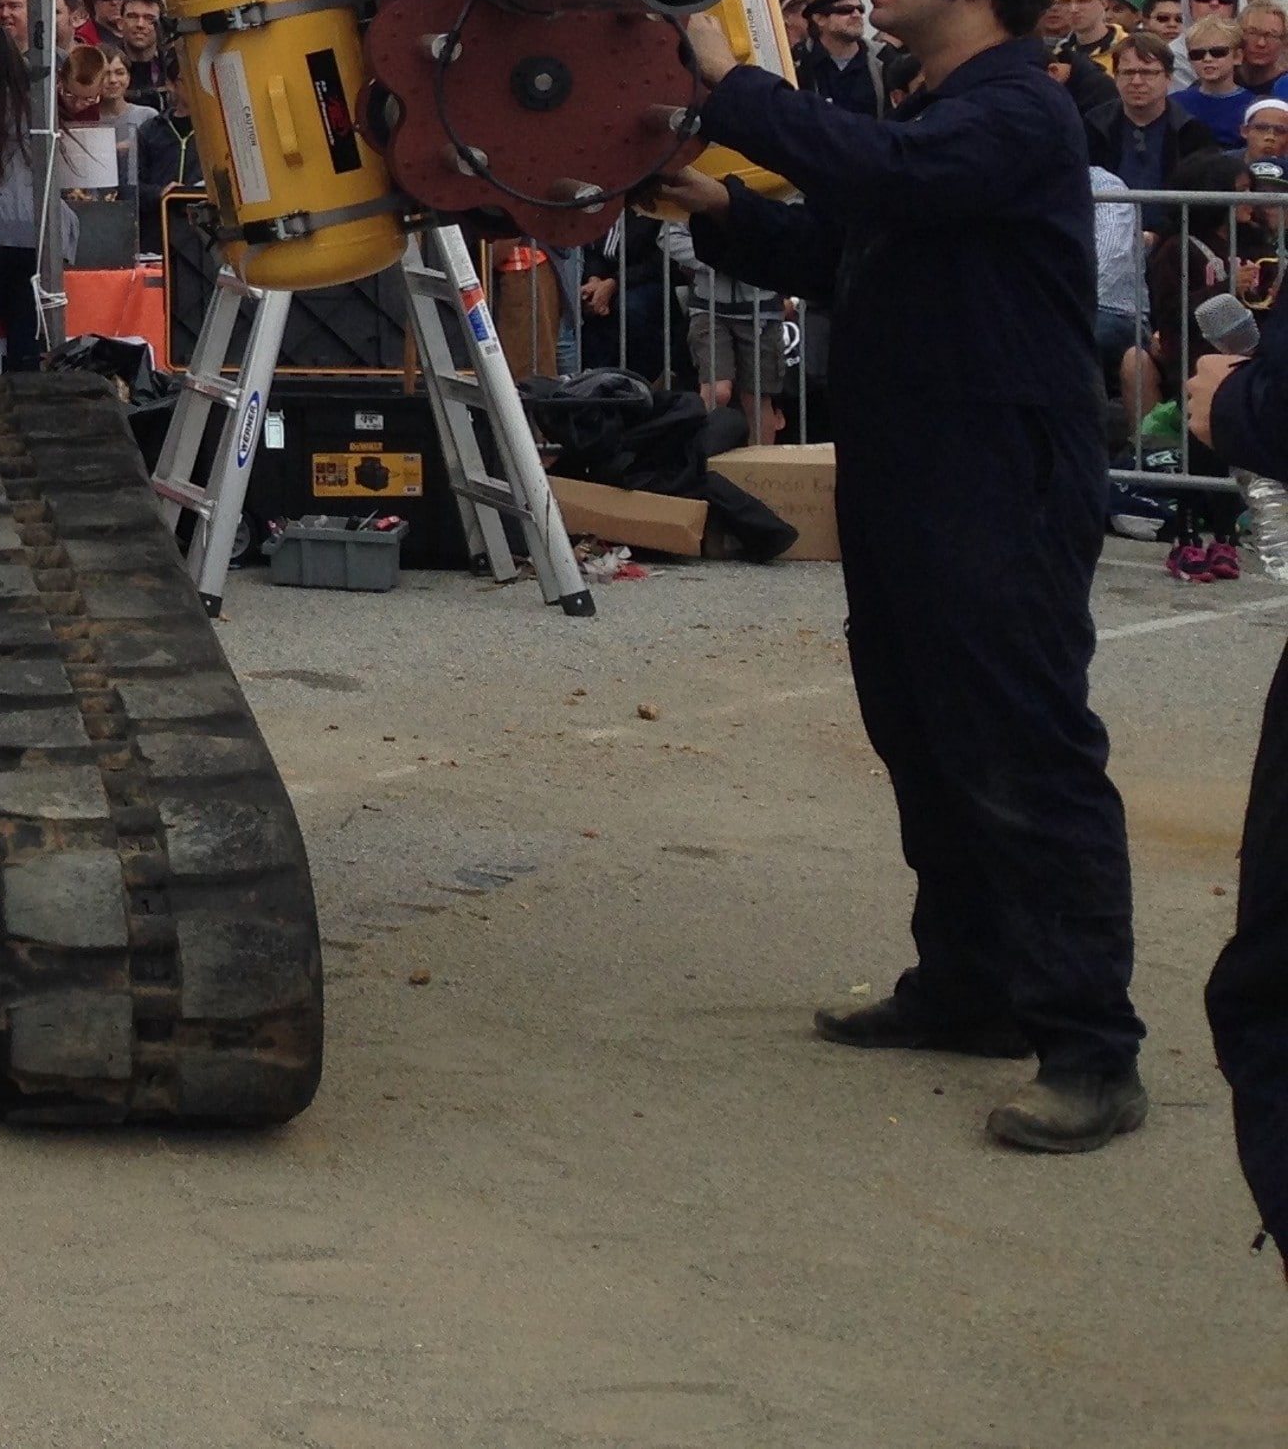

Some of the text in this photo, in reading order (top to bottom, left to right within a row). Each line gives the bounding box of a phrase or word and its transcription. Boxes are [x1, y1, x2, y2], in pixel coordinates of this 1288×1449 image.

[746, 8, 761, 49] CAUTION
[242, 105, 258, 147] CAUTION
[239, 405, 257, 453] WERNER
